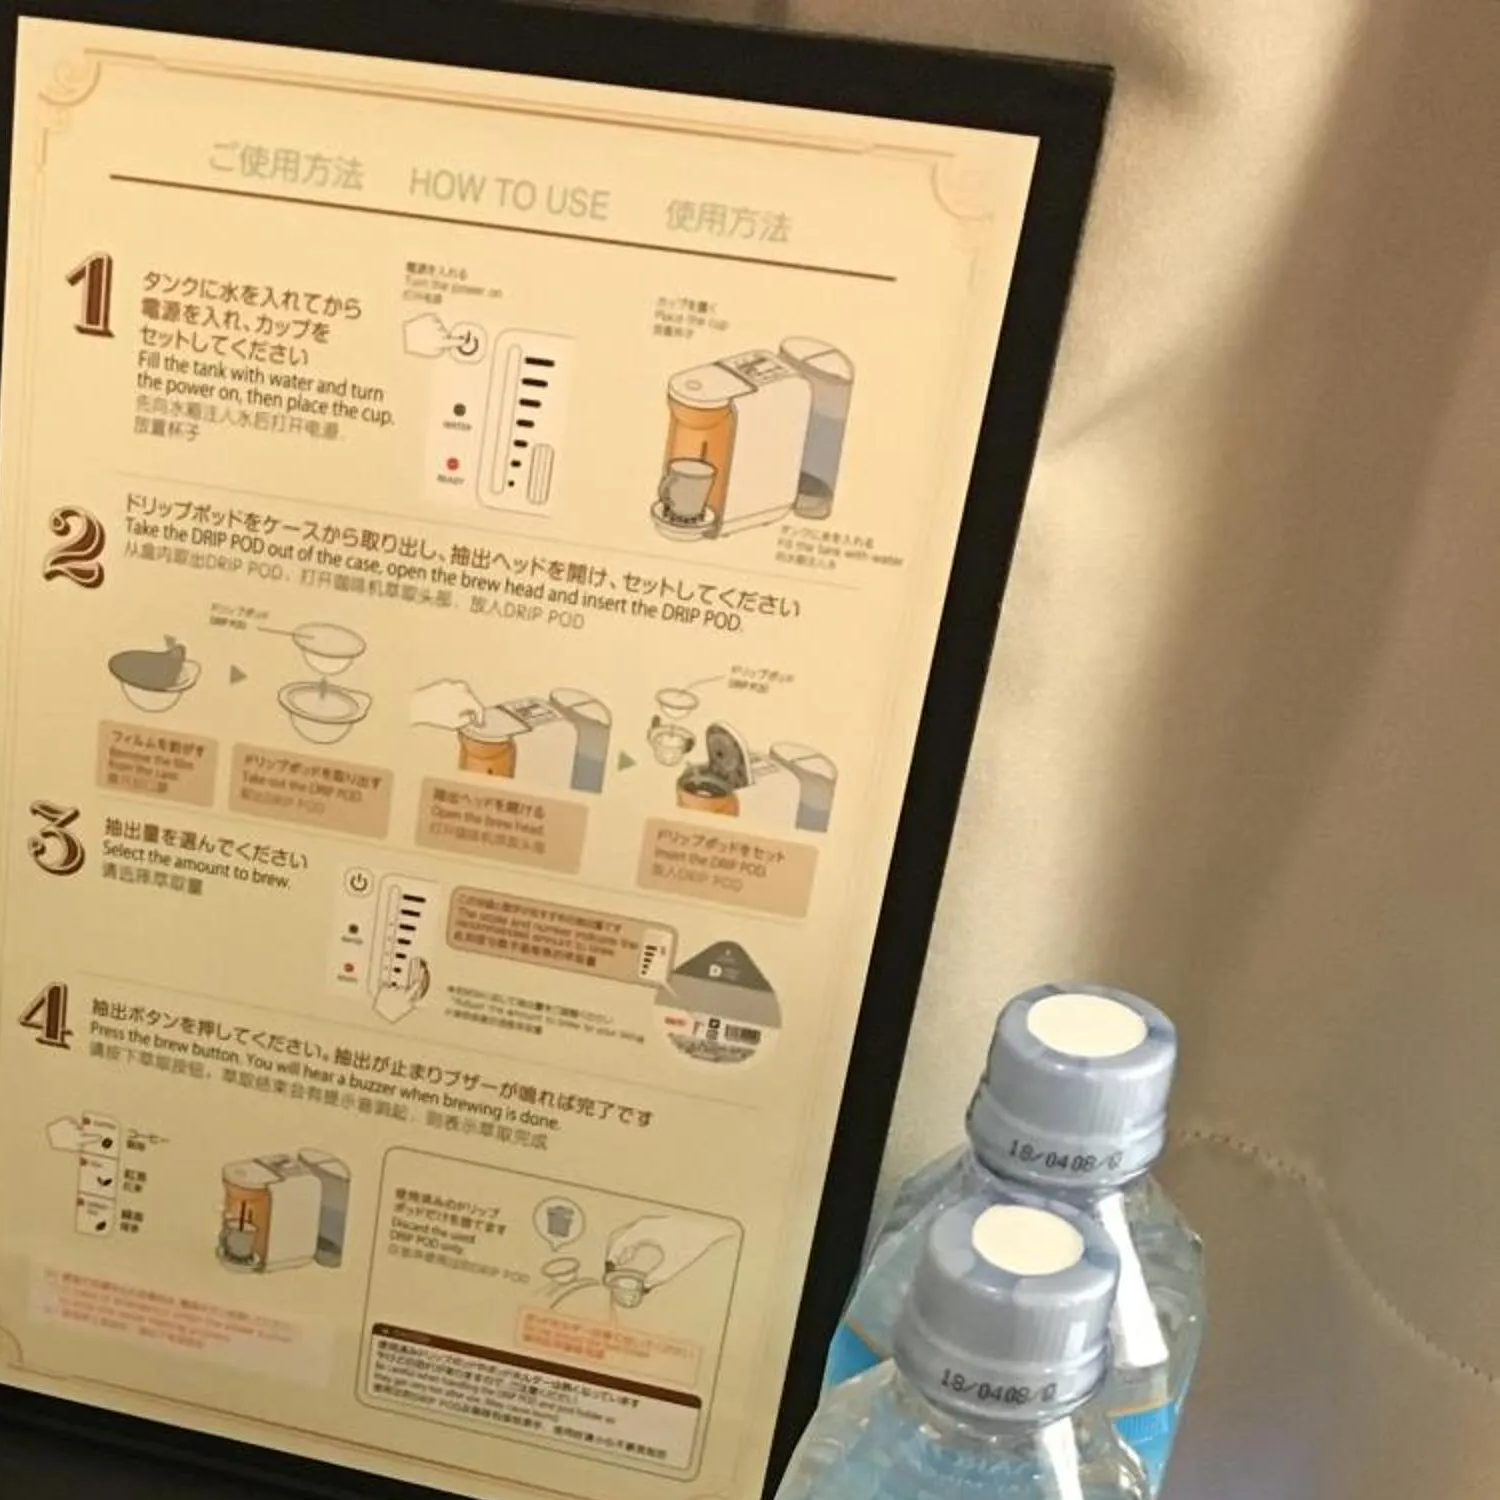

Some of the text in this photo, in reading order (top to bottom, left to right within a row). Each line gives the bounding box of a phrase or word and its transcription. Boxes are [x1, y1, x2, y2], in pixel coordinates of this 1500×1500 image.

[207, 140, 365, 192] ご使用方法
[407, 166, 611, 222] HOW TO USE
[664, 197, 792, 244] 使用方法
[65, 250, 115, 338] 1
[142, 269, 362, 320] タンクに水を入れてから
[138, 323, 309, 367] セットしてください
[136, 369, 162, 391] the
[165, 377, 216, 399] power
[245, 385, 283, 409] then
[286, 391, 329, 416] place
[330, 398, 359, 420] the
[360, 405, 395, 427] cup.
[137, 348, 384, 403] Fill the tank with water and turn
[42, 505, 107, 590] 2
[124, 516, 160, 539] Take
[162, 522, 188, 543] the
[190, 526, 225, 549] DRIP
[229, 533, 265, 555] POD
[266, 542, 294, 561] out
[296, 544, 314, 562] of
[315, 546, 343, 568] the
[386, 561, 427, 581] open
[430, 565, 458, 587] the
[459, 569, 502, 593] brew
[502, 576, 545, 601] head
[546, 587, 580, 606] and
[581, 590, 628, 615] insert
[630, 597, 658, 619] the
[659, 601, 701, 624] DRIP
[29, 802, 86, 877] 3
[101, 838, 145, 862] Select
[147, 847, 172, 867] the
[173, 855, 231, 879] amount
[233, 864, 249, 882] to
[103, 815, 308, 869] 抽出量を選んでください
[17, 982, 74, 1051] 4
[89, 1019, 125, 1041] Press
[127, 1027, 152, 1047] the
[152, 1032, 188, 1054] brew
[244, 1051, 273, 1072] You
[276, 1059, 301, 1077] will
[302, 1062, 334, 1083] hear
[336, 1072, 346, 1087] a
[348, 1072, 396, 1096] buzzer
[398, 1085, 440, 1105] when
[442, 1091, 502, 1118] brewing
[504, 1104, 517, 1122] is
